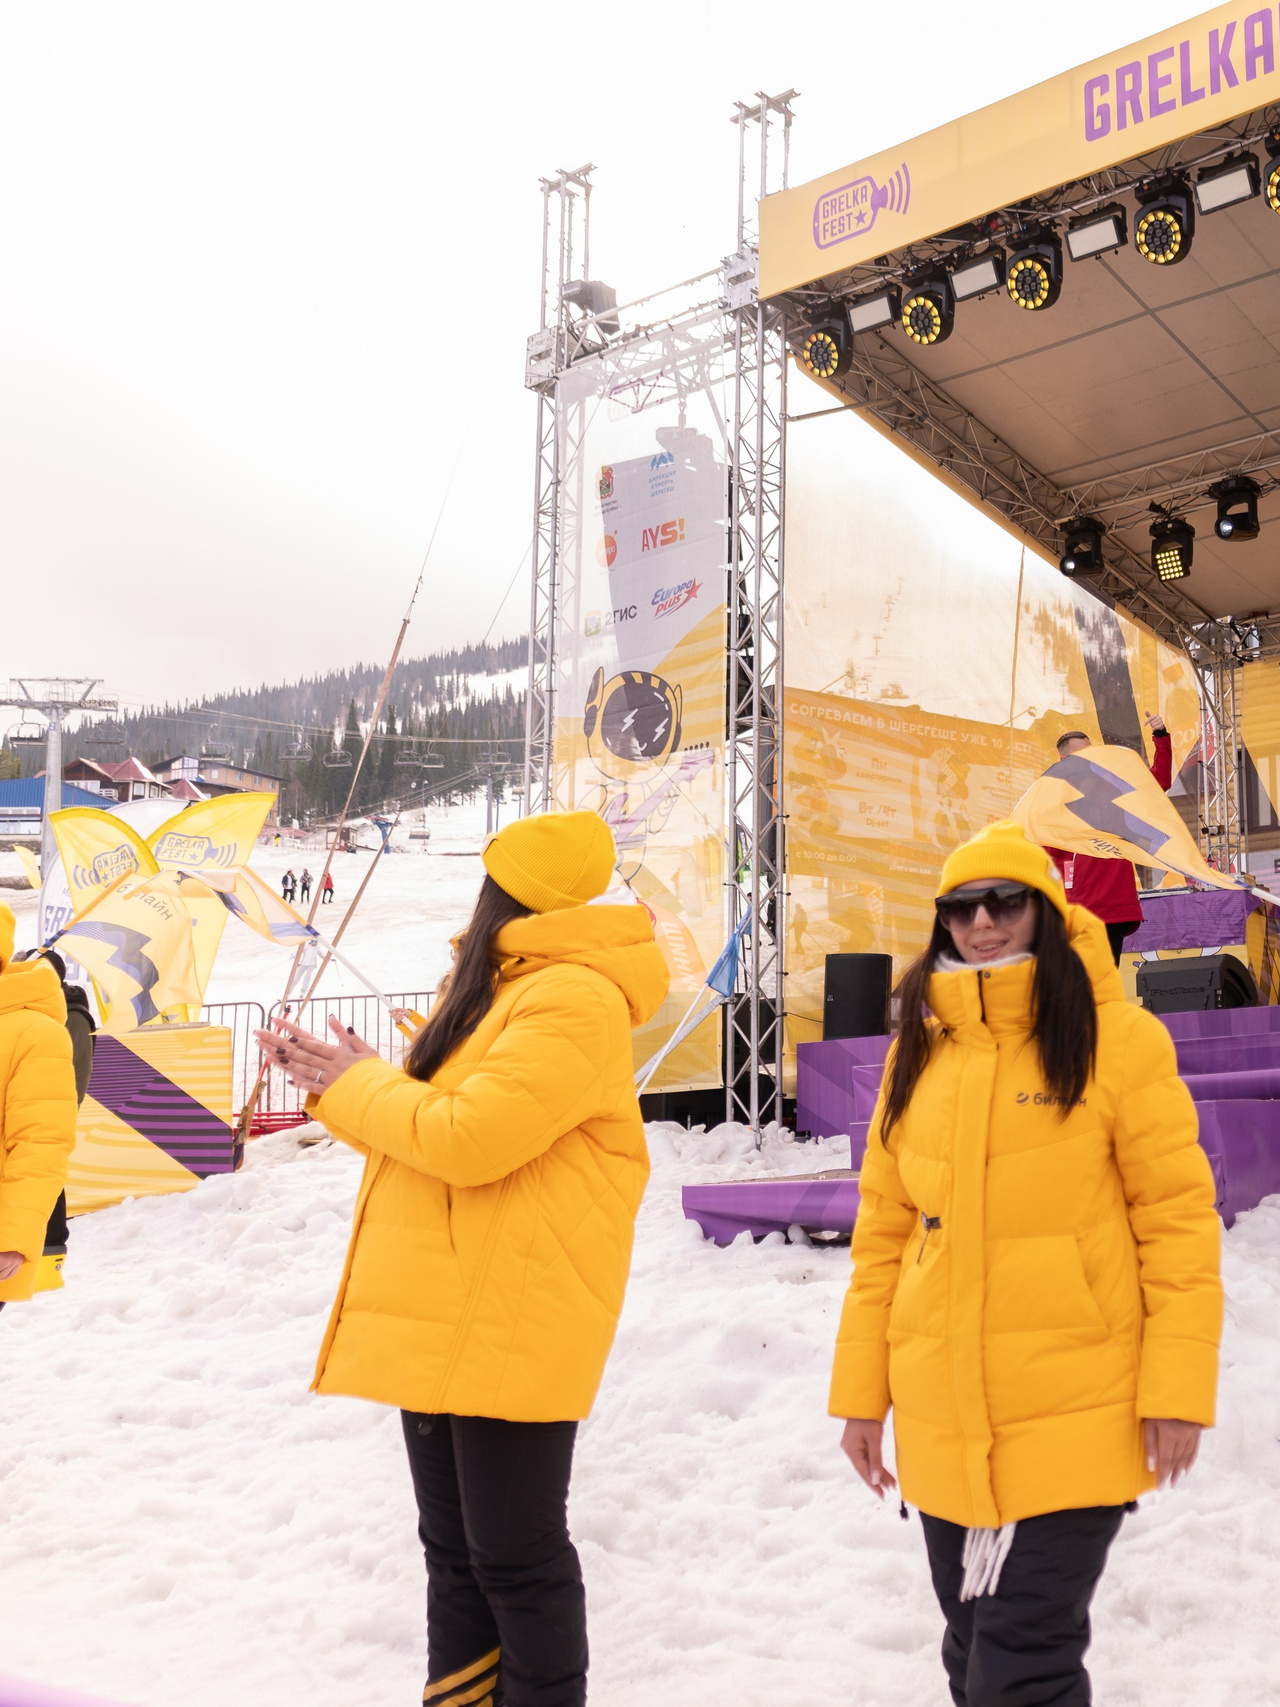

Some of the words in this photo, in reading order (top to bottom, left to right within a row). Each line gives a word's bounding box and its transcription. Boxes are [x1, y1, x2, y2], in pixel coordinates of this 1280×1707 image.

[822, 185, 868, 220] GRELKA
[823, 212, 853, 240] FEST
[641, 518, 685, 552] AYS!
[605, 605, 638, 627] 2ГИС
[789, 702, 873, 729] СОГРЕВАЕМ
[876, 717, 886, 729] В
[888, 719, 958, 741] ШЕРЕГЕШЕ
[961, 732, 988, 747] УЖЕ
[991, 737, 1003, 749] 10
[866, 817, 889, 828] Dj-set
[161, 848, 188, 860] FEST
[167, 836, 205, 850] GRELKA
[116, 883, 173, 921] блайн
[1033, 1092, 1087, 1108] билн
